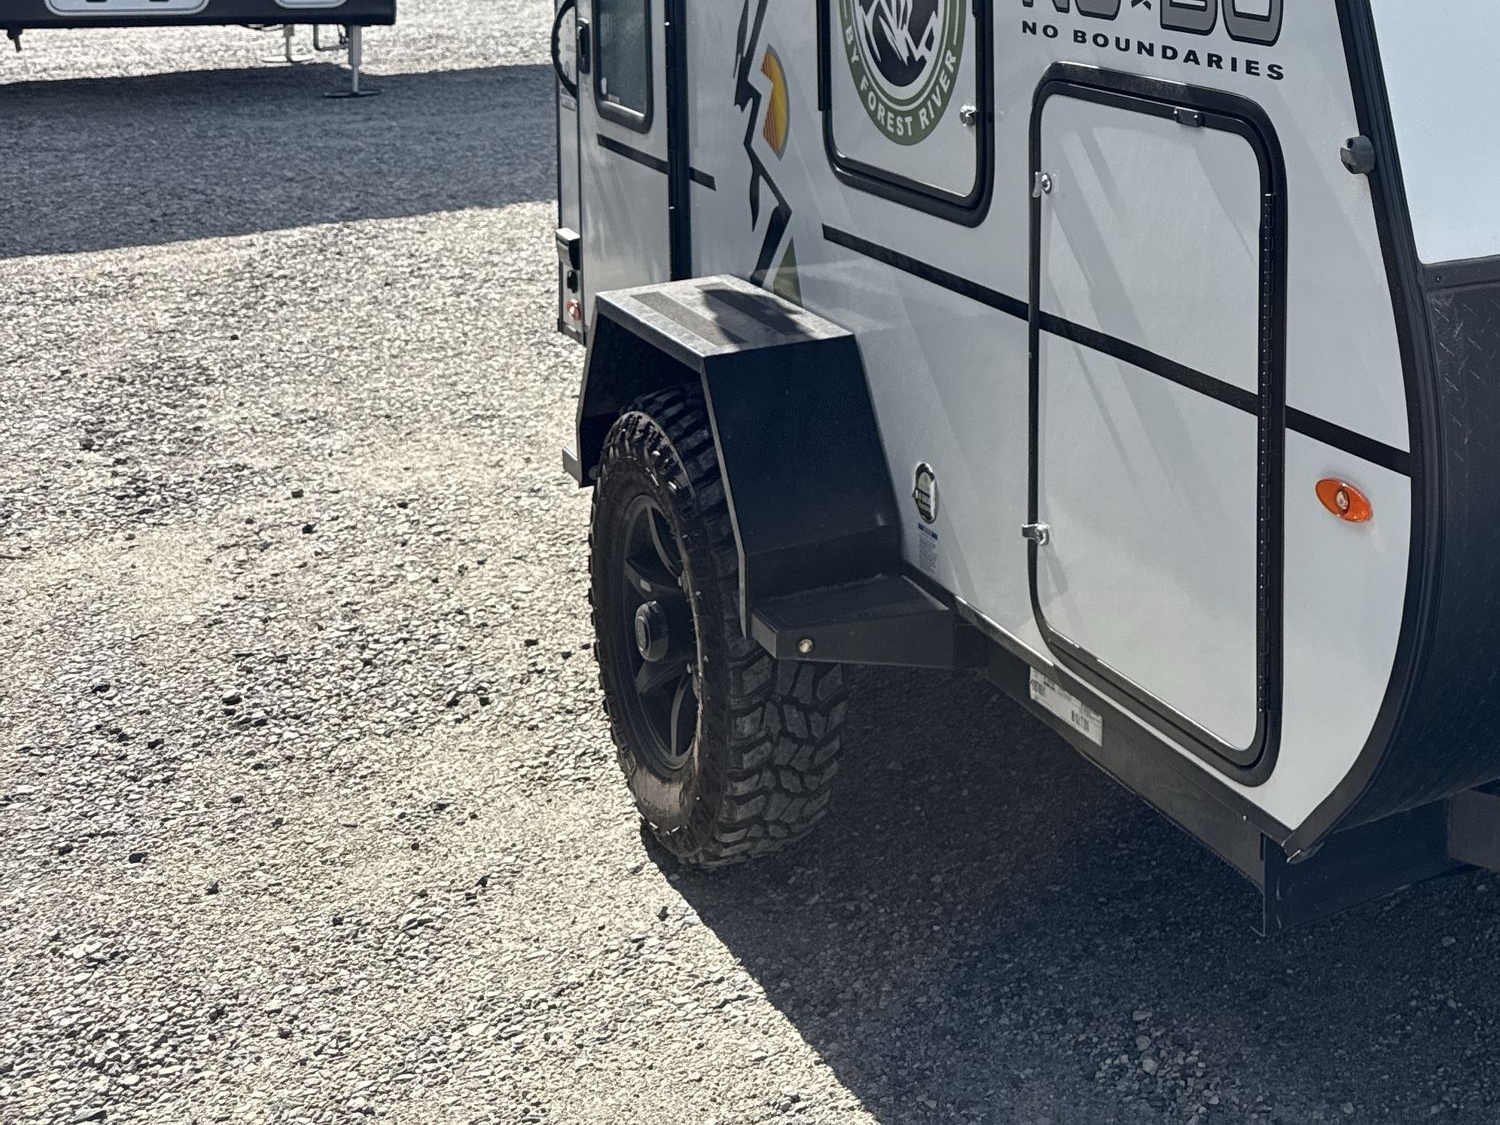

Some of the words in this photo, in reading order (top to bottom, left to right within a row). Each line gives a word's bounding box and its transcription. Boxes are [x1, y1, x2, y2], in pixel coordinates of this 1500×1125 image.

[845, 25, 860, 64] BY
[860, 75, 913, 137] FOREST
[918, 49, 957, 130] RIVER
[1022, 20, 1059, 39] NO
[1073, 29, 1285, 81] BOUNDARIES
